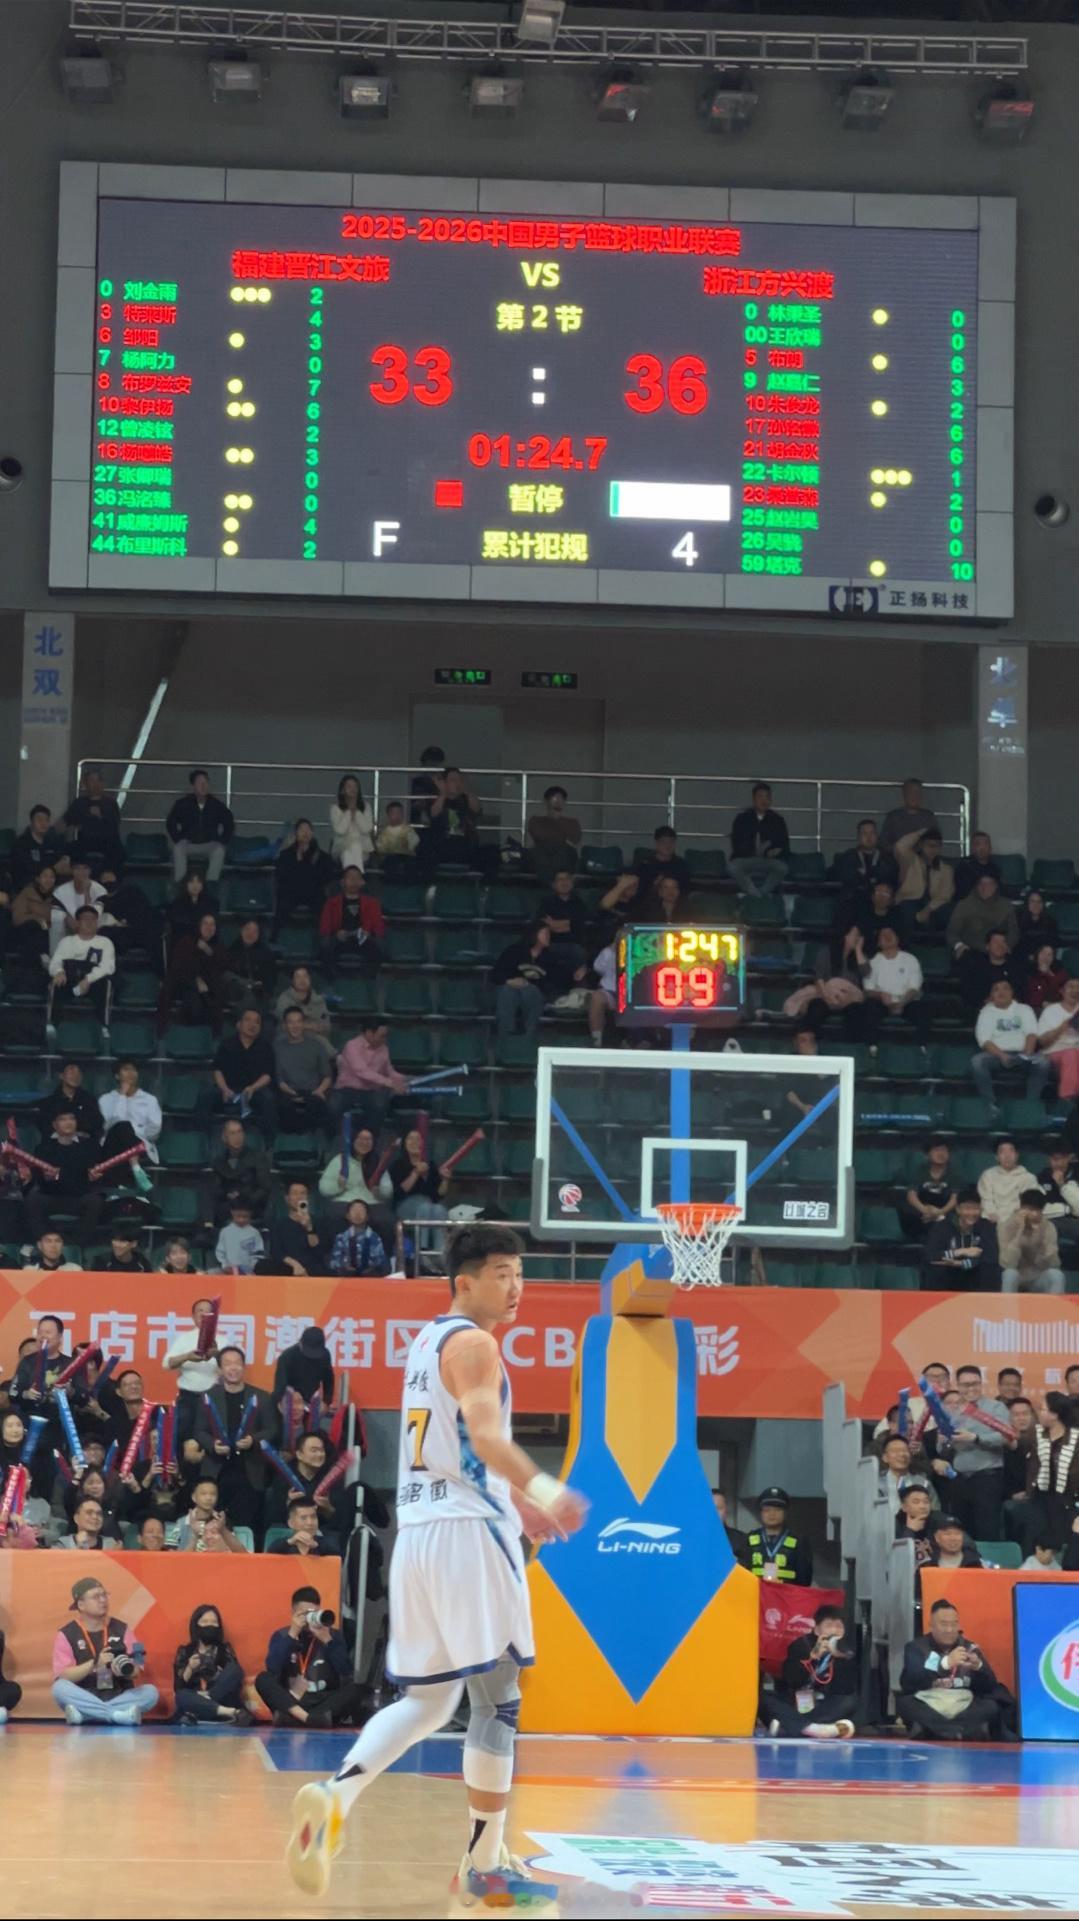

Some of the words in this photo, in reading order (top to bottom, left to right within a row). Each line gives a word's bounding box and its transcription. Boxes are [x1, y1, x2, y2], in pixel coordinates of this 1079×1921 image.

[342, 214, 742, 256] 2025-2026中国男子篮球职业联赛
[231, 250, 390, 283] 福建晋江文旅
[520, 262, 560, 288] VS
[704, 266, 834, 299] 浙江方兴渡
[310, 288, 322, 305] 2
[309, 311, 322, 327] 4
[951, 310, 965, 328] 0
[310, 333, 322, 350] 3
[951, 333, 965, 351] 0
[309, 356, 322, 374] 0
[951, 356, 965, 374] 6
[309, 379, 321, 396] 7
[370, 345, 453, 405] 33
[625, 354, 708, 414] 36
[951, 379, 964, 397] 3
[306, 402, 320, 420] 6
[950, 402, 964, 420] 2
[306, 425, 319, 443] 2
[949, 424, 964, 442] 6
[306, 448, 319, 466] 3
[468, 434, 607, 470] 01:24.7
[949, 447, 963, 466] 6
[305, 472, 318, 489] 0
[952, 470, 961, 487] 1
[305, 494, 318, 512] 0
[508, 484, 564, 514] 暂停
[949, 493, 963, 512] 2
[304, 518, 317, 535] 4
[949, 515, 963, 535] 0
[373, 521, 400, 557] F
[482, 530, 588, 561] 累计犯规
[949, 538, 963, 557] 0
[304, 541, 316, 559] 2
[671, 531, 699, 566] 4
[951, 562, 973, 580] 10
[889, 590, 970, 609] 正扬科技
[657, 966, 714, 1007] 09
[597, 1541, 681, 1554] LI-NING
